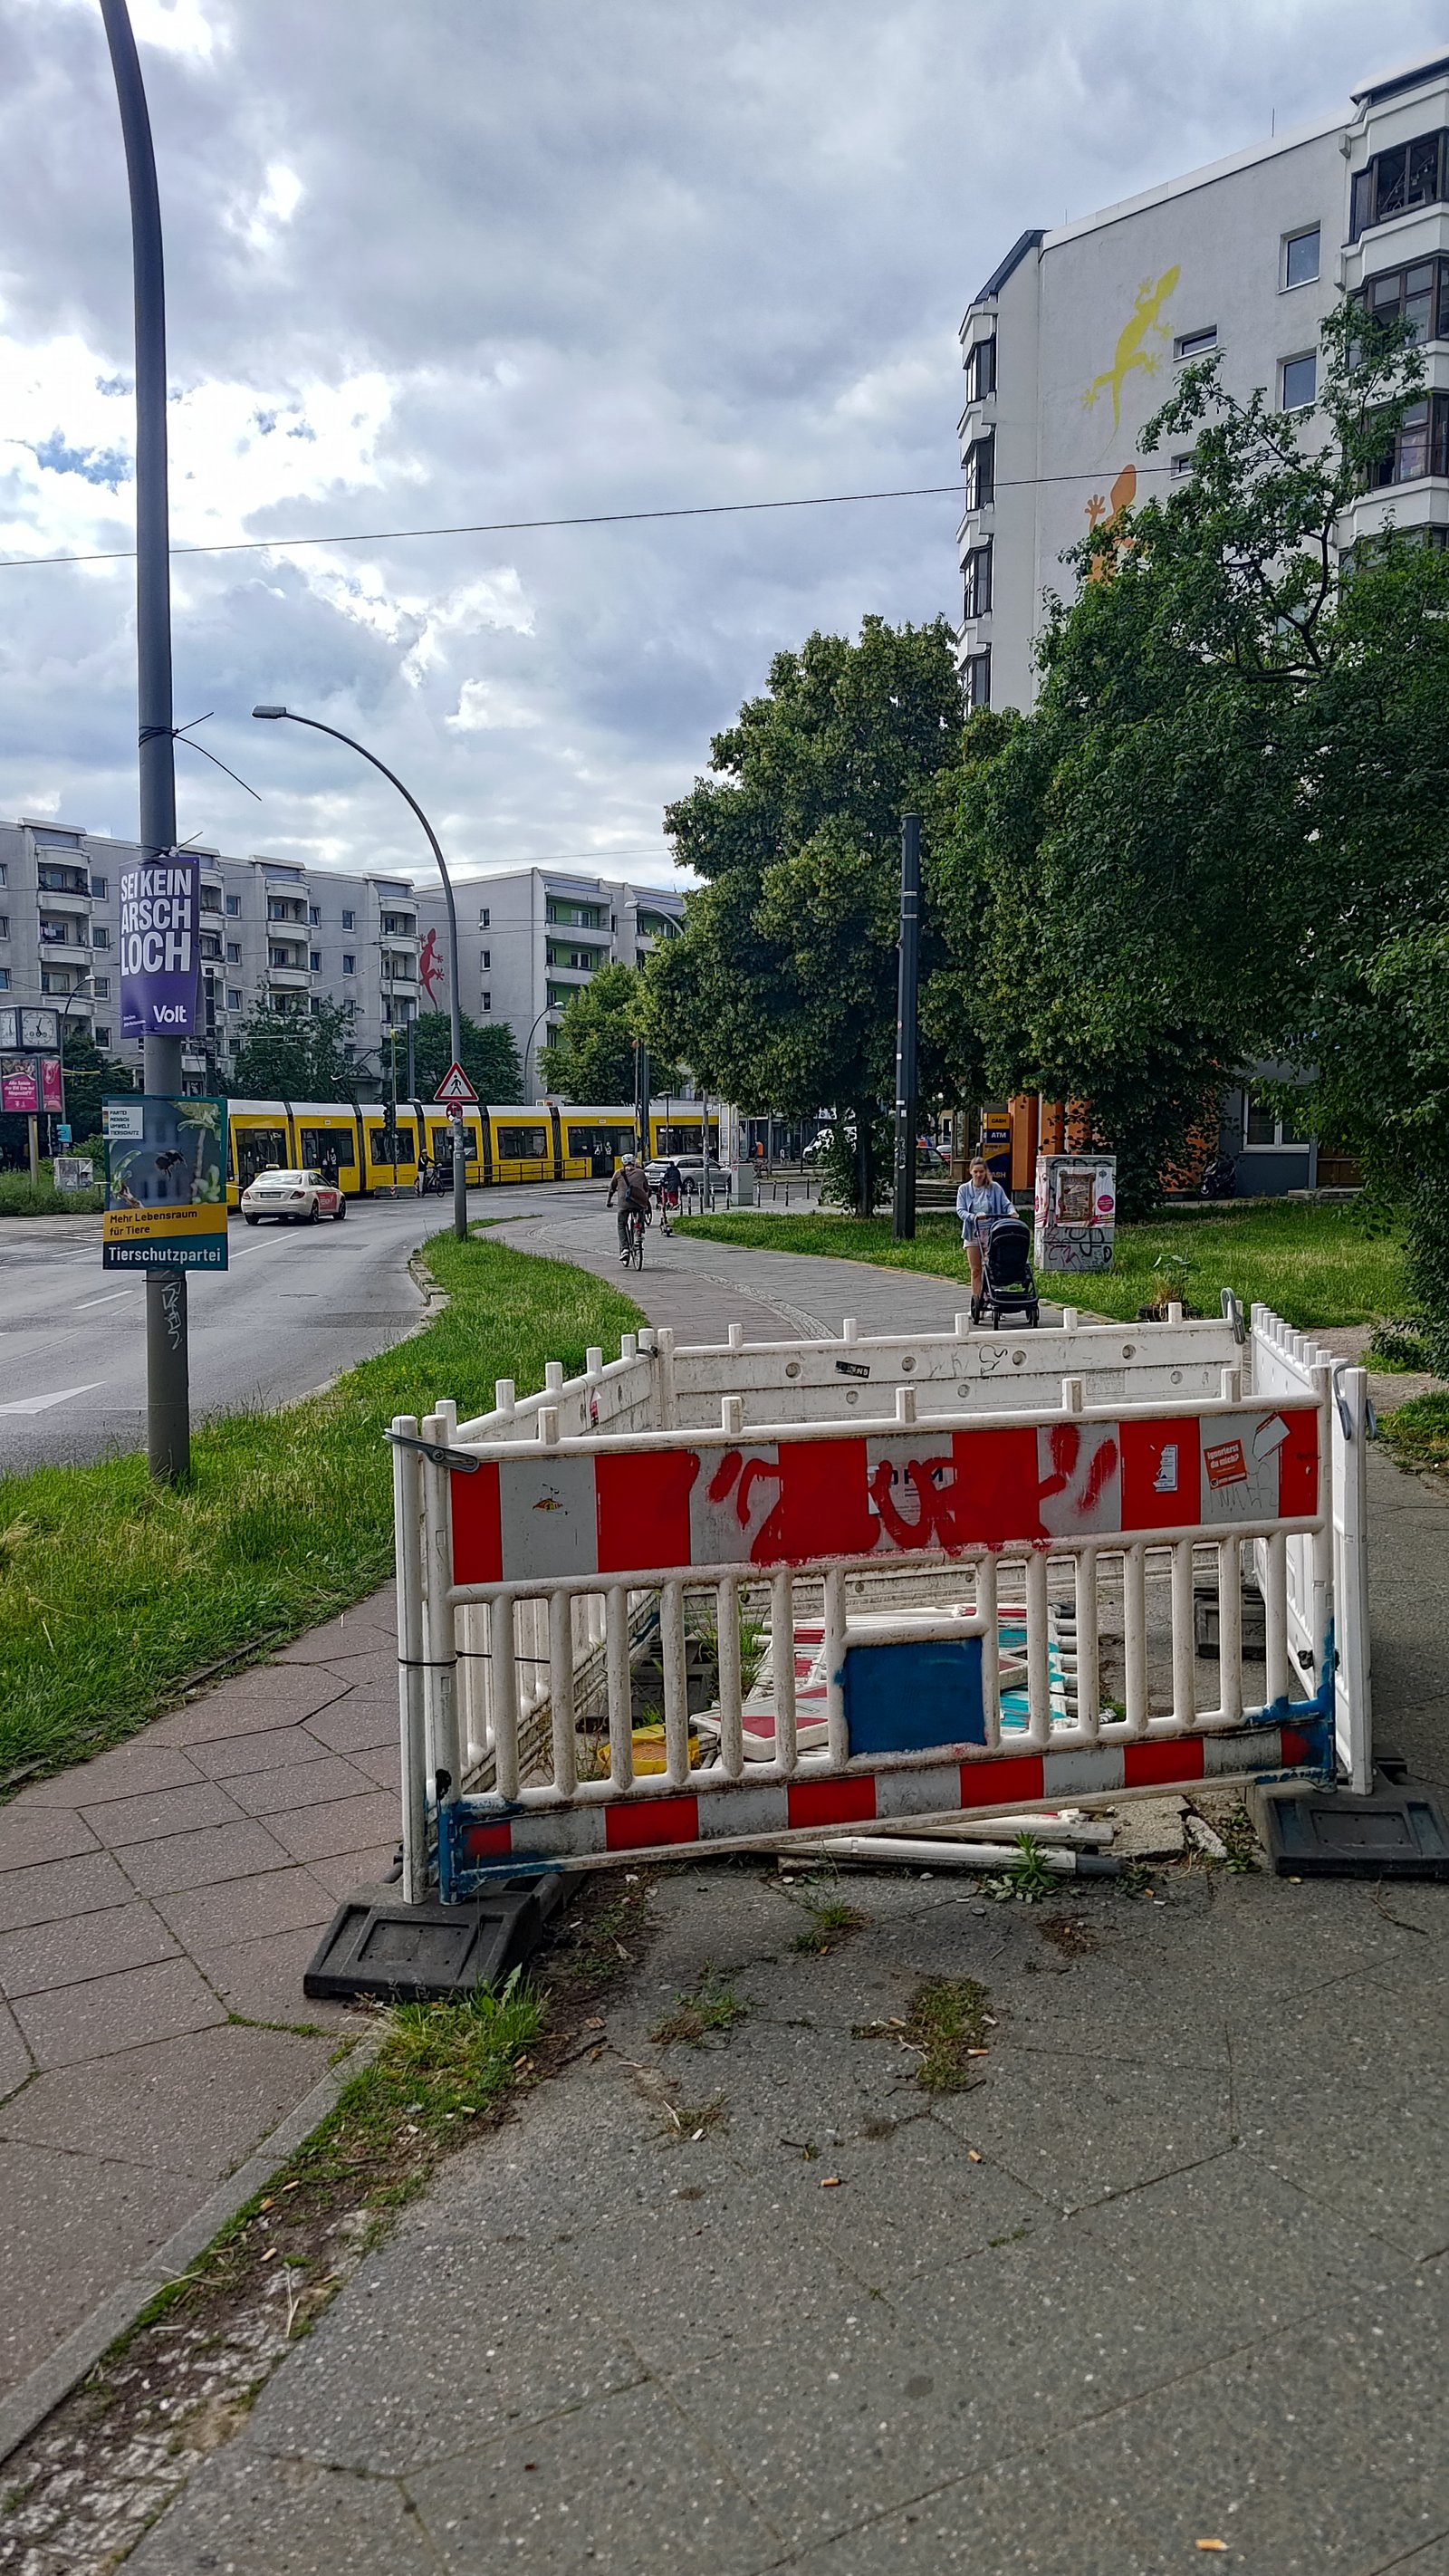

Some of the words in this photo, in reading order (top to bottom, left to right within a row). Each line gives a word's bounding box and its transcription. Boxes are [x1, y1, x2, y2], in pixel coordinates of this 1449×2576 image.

[121, 872, 138, 902] SEI
[140, 869, 191, 897] KEIN
[121, 899, 191, 935] ARSCH
[121, 931, 190, 976] LOCH
[153, 1005, 187, 1024] Volt
[110, 1215, 133, 1224] Mehr
[135, 1210, 197, 1222] Lebensraum
[110, 1226, 124, 1235] für
[126, 1226, 150, 1235] Tiere
[109, 1246, 221, 1264] Tierschutzpartei
